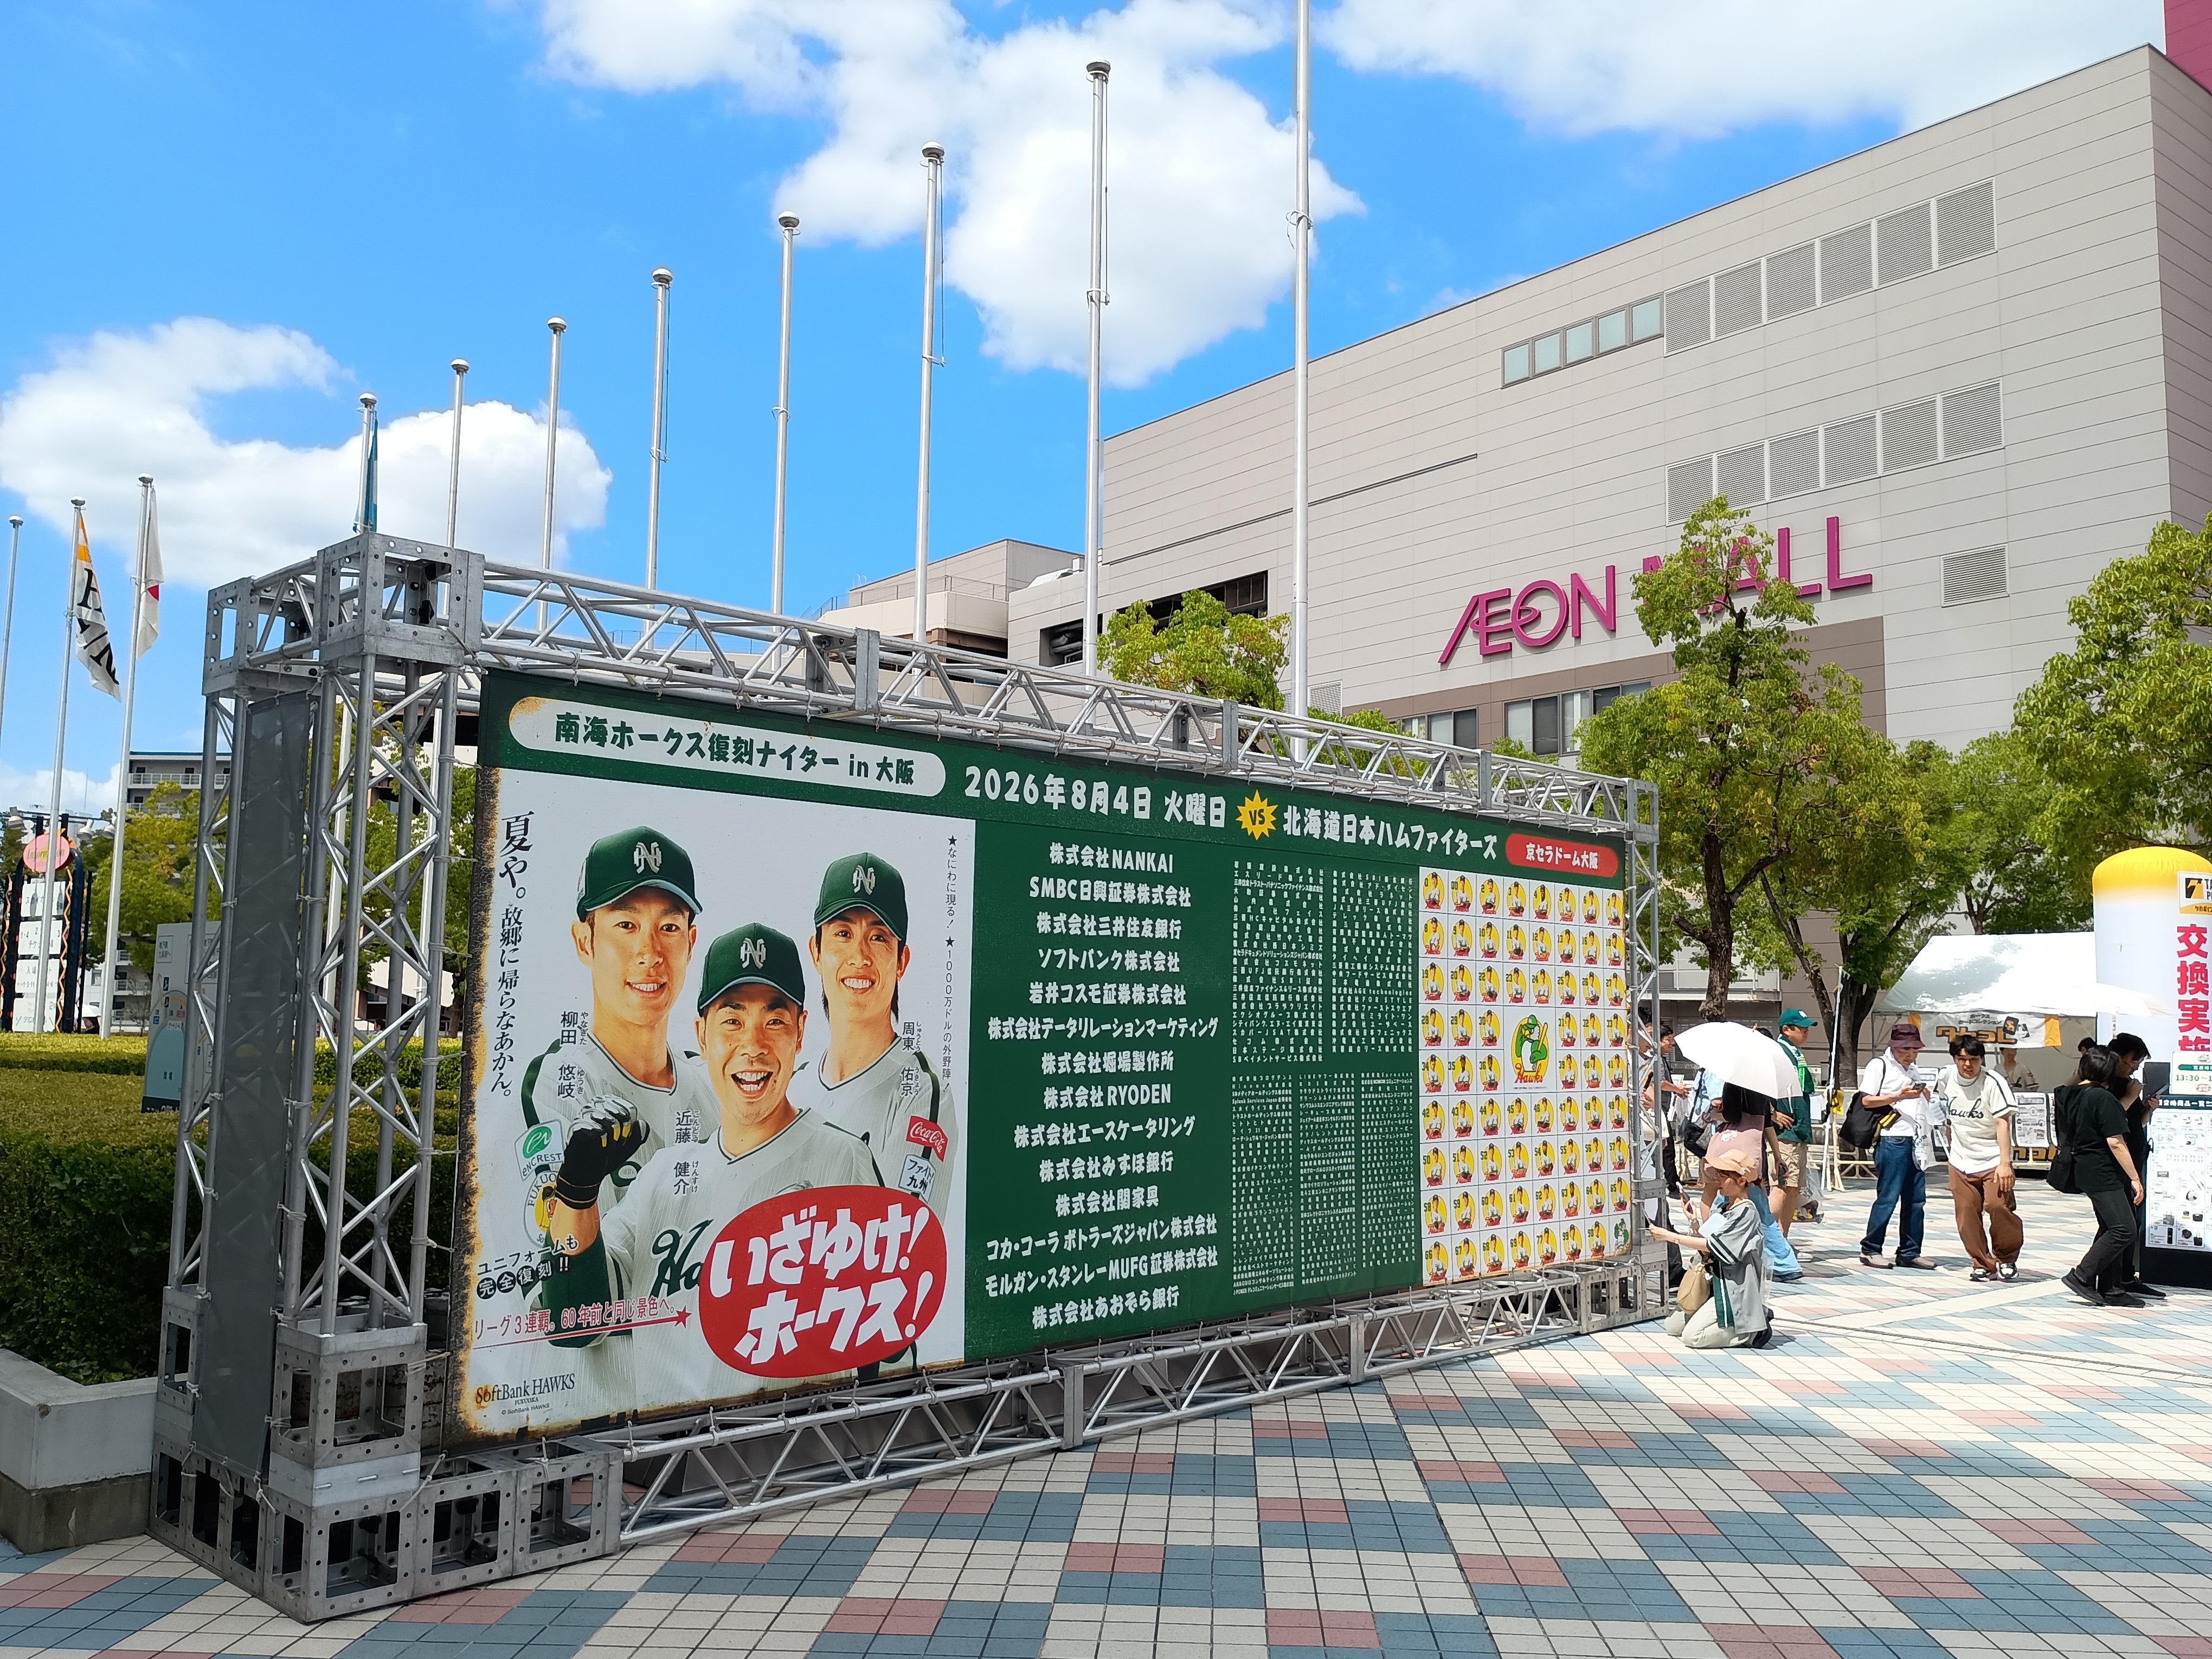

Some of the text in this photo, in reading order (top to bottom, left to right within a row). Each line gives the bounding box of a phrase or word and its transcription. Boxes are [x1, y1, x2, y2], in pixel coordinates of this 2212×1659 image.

[555, 712, 915, 786] 南海ホークス復刻ナイター in 大阪
[964, 766, 1226, 828] 2026年8月4日 火曜日
[1248, 807, 1265, 826] VS
[1283, 805, 1496, 859] 北海道日本ハムファイターズ
[1526, 842, 1599, 870] 京セラドーム大阪
[1425, 878, 1428, 886] 0
[1451, 881, 1458, 890] 00
[1030, 876, 1191, 907] SMBC日興証券株式会社
[1534, 890, 1537, 898] 4
[1037, 911, 1182, 940] 株式会社三井住友銀行
[1425, 924, 1427, 932] 8
[1454, 926, 1456, 934] 9
[1480, 928, 1484, 936] 10
[1533, 933, 1538, 941] 12
[1558, 935, 1562, 943] 13
[1038, 948, 1180, 972] ソフトバンク株式会社
[1422, 969, 1428, 978] 19
[1451, 971, 1457, 980] 20
[1479, 973, 1485, 981] 22
[1506, 974, 1512, 982] 23
[1029, 981, 1186, 1005] 岩井コスモ証券株式会社
[1422, 1015, 1429, 1024] 28
[1451, 1016, 1457, 1025] 29
[1479, 1017, 1486, 1025] 30
[988, 1016, 1219, 1040] 株式会社データリレーションマーケティング
[1041, 1050, 1174, 1075] 株式会社堀場製作所
[1422, 1062, 1429, 1071] 34
[1448, 1062, 1455, 1070] 35
[1480, 1062, 1486, 1070] 36
[1452, 1107, 1458, 1116] 43
[1480, 1106, 1486, 1115] 44
[1507, 1105, 1514, 1113] 45
[1560, 1103, 1565, 1111] 47
[1422, 1109, 1429, 1117] 42
[1014, 1115, 1195, 1148] 株式会社エースケータリング
[1508, 1149, 1514, 1158] 53
[1535, 1148, 1541, 1156] 54
[1560, 1146, 1566, 1154] 55
[1423, 1155, 1430, 1165] 50
[1453, 1153, 1459, 1162] 51
[1481, 1151, 1487, 1160] 52
[1039, 1150, 1174, 1182] 株式会社みずほ銀行
[906, 1175, 929, 1194] 九州
[528, 1173, 557, 1207] FUKUO
[1561, 1189, 1567, 1197] 63
[1509, 1194, 1515, 1203] 61
[1536, 1191, 1541, 1200] 62
[1056, 1185, 1159, 1217] 株式会社関家具
[1454, 1199, 1460, 1208] 59
[1482, 1197, 1488, 1205] 60
[1424, 1203, 1431, 1212] 58
[1588, 1229, 1593, 1237] 90
[1510, 1238, 1516, 1248] 69
[1536, 1235, 1542, 1244] 77
[1455, 1246, 1462, 1255] 67
[1483, 1242, 1489, 1251] 68
[478, 1234, 578, 1276] ユニフォームも
[1032, 1285, 1180, 1330] 株式会社あおぞら銀行
[475, 1373, 575, 1404] SoftBank HAWKS
